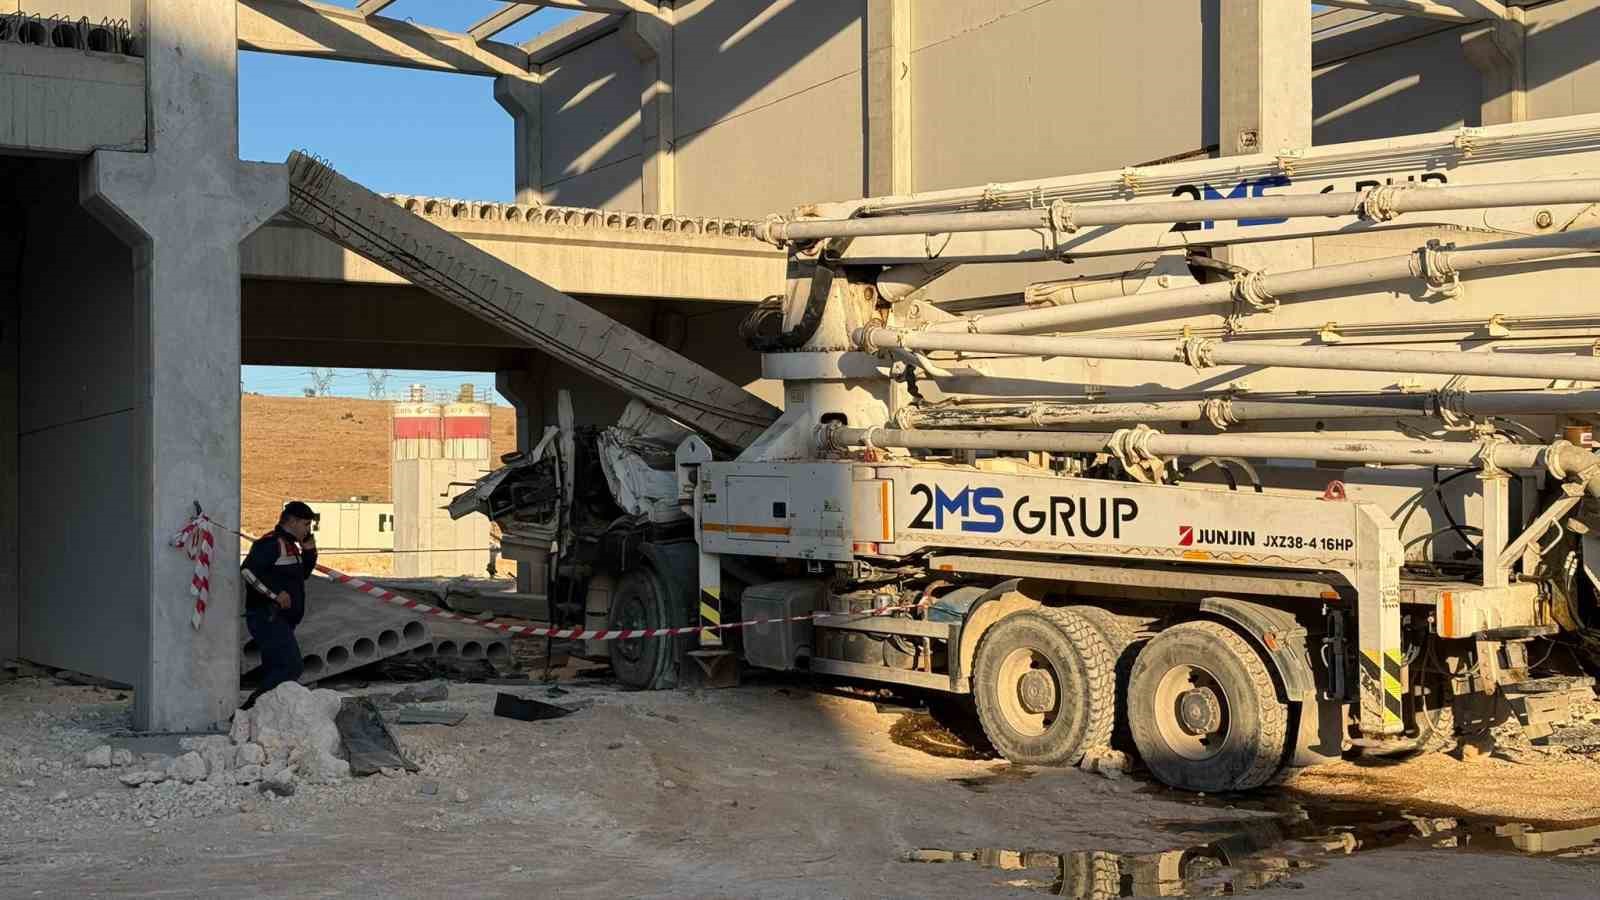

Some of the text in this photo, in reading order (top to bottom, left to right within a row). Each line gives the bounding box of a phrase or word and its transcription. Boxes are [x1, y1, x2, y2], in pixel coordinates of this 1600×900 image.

[907, 483, 1139, 539] 2MS GRUP
[1196, 528, 1256, 547] JUNJIN
